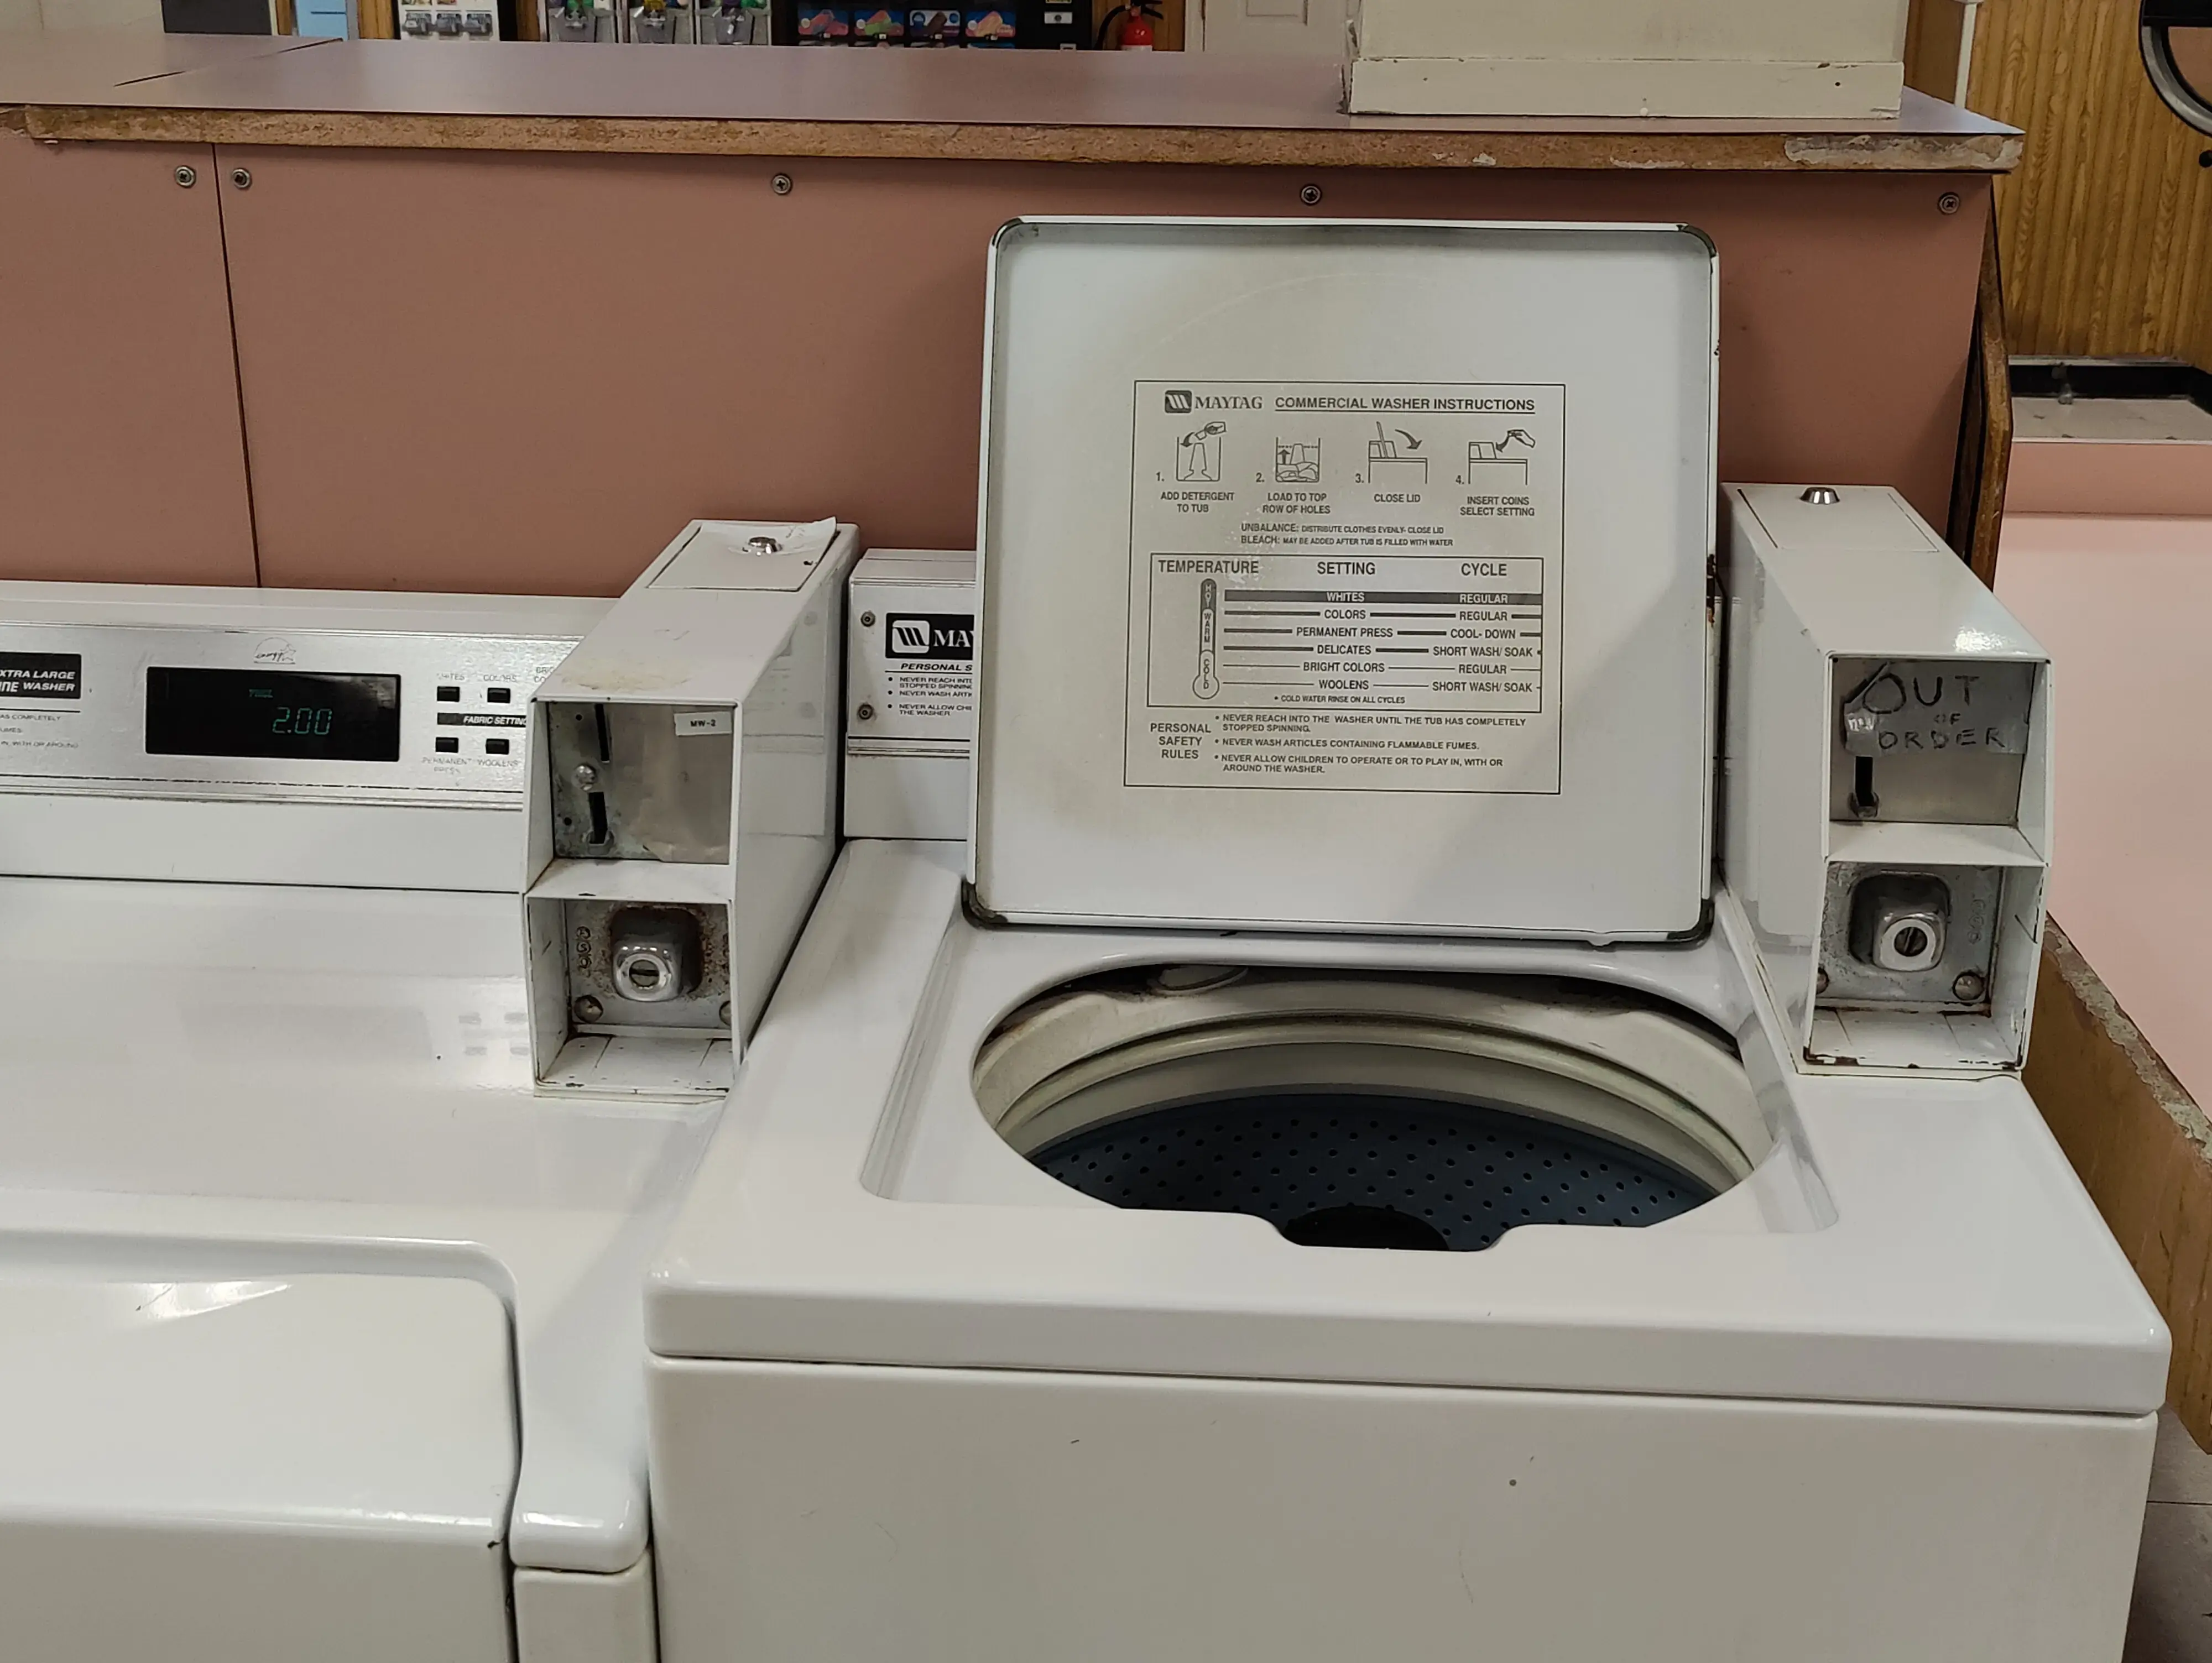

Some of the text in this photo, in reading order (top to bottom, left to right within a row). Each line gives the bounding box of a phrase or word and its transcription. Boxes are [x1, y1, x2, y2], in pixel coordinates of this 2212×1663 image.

[1196, 397, 1262, 409] MAYTAG
[1276, 398, 1535, 410] COMMERCIAL WASHER INSTRUCTIONS
[1156, 472, 1164, 481] 1.
[1256, 473, 1264, 482] 2.
[1355, 473, 1364, 483] 3.
[1455, 475, 1464, 484] 4.
[1161, 491, 1234, 500] ADD DETERGENT
[1268, 493, 1327, 501] LOAD TO TOP
[1374, 494, 1404, 503] CLOSE
[1468, 496, 1499, 505] INSERT
[1177, 504, 1208, 513] TO TUB
[1262, 505, 1331, 514] ROW OF HOLES
[1460, 507, 1534, 516] SELECT SETTING
[1241, 524, 1298, 532] UNBALANCE:
[1241, 536, 1280, 544] BLEACH:
[1159, 560, 1259, 573] TEMPERATURE
[1318, 562, 1375, 574] SETTING
[1462, 563, 1506, 576] CYCLE
[1327, 593, 1365, 602] WHITES
[1460, 594, 1508, 603] REGULAR
[1324, 610, 1365, 619] COLORS
[1460, 611, 1507, 621] REGULAR
[1297, 627, 1393, 637] PERMANENT PRESS
[1485, 629, 1515, 639] DOWN
[933, 630, 973, 647] MA
[1318, 645, 1371, 655] DELICATES
[1433, 647, 1467, 655] SHORT
[1505, 647, 1532, 657] SOAK
[1304, 662, 1385, 672] BRIGHT COLORS
[1459, 665, 1506, 674] REGULAR
[33, 671, 75, 679] LARGE
[23, 682, 75, 691] WASHER
[1319, 680, 1369, 689] WOOLENS
[1432, 682, 1467, 691] SHORT
[1504, 683, 1532, 692] SOAK
[1862, 673, 1980, 714] OUT
[272, 707, 332, 734] 2.00
[463, 716, 493, 724] FABRIC
[1151, 723, 1211, 733] PERSONAL
[1159, 736, 1202, 745] SAFETY
[1879, 728, 2005, 749] ORDER
[1162, 749, 1198, 759] RULES
